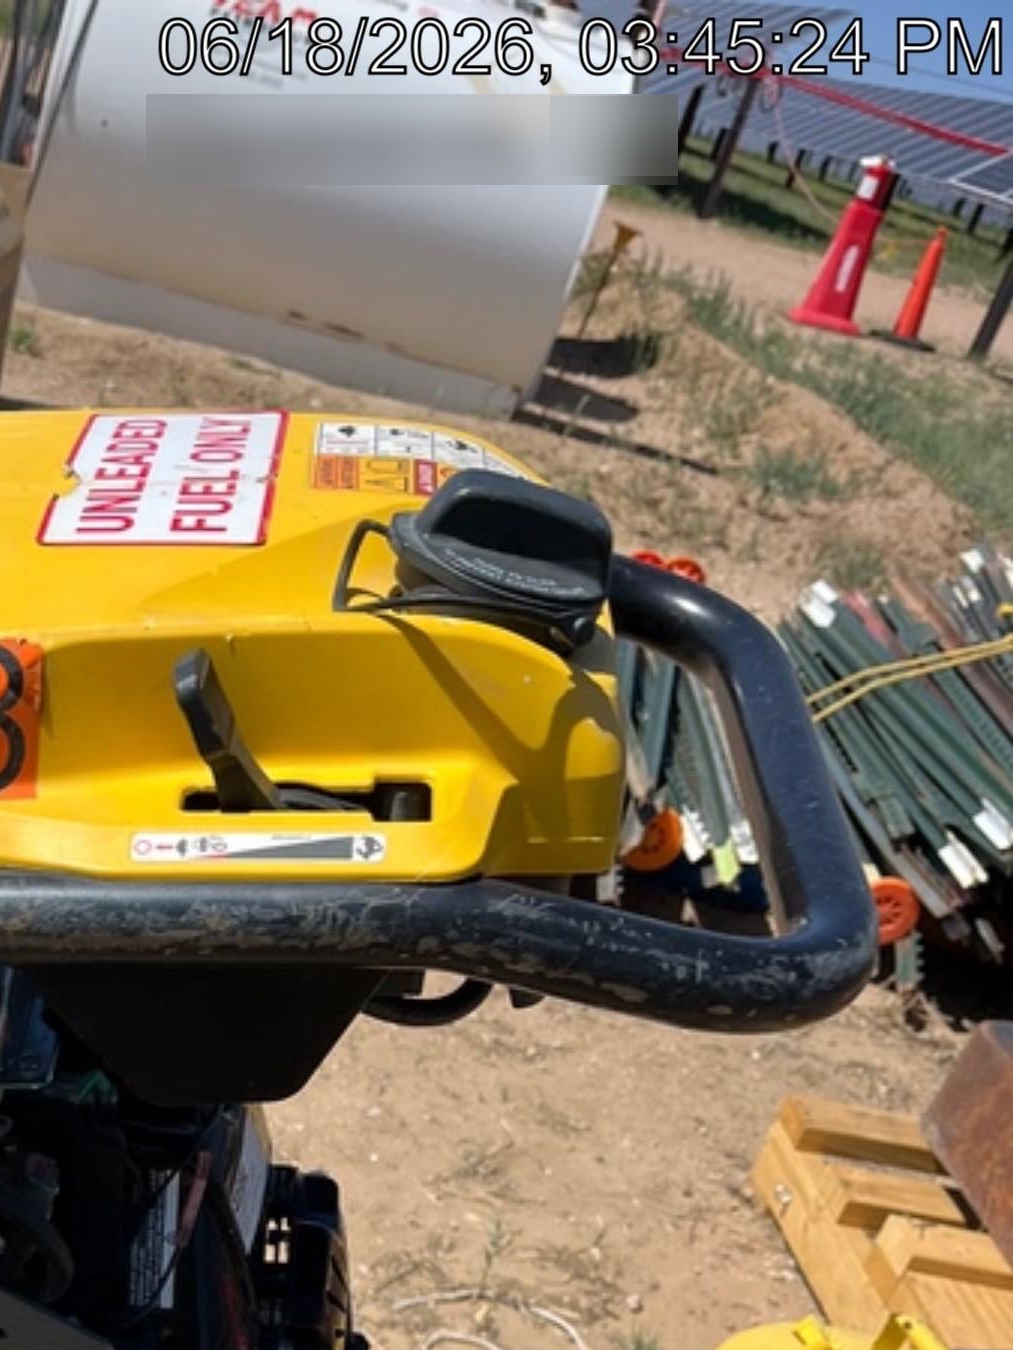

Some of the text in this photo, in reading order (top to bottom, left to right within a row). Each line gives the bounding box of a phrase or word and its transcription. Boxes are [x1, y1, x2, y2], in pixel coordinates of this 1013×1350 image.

[75, 419, 168, 534] UNLEADED
[170, 416, 252, 533] FUEL ONLY
